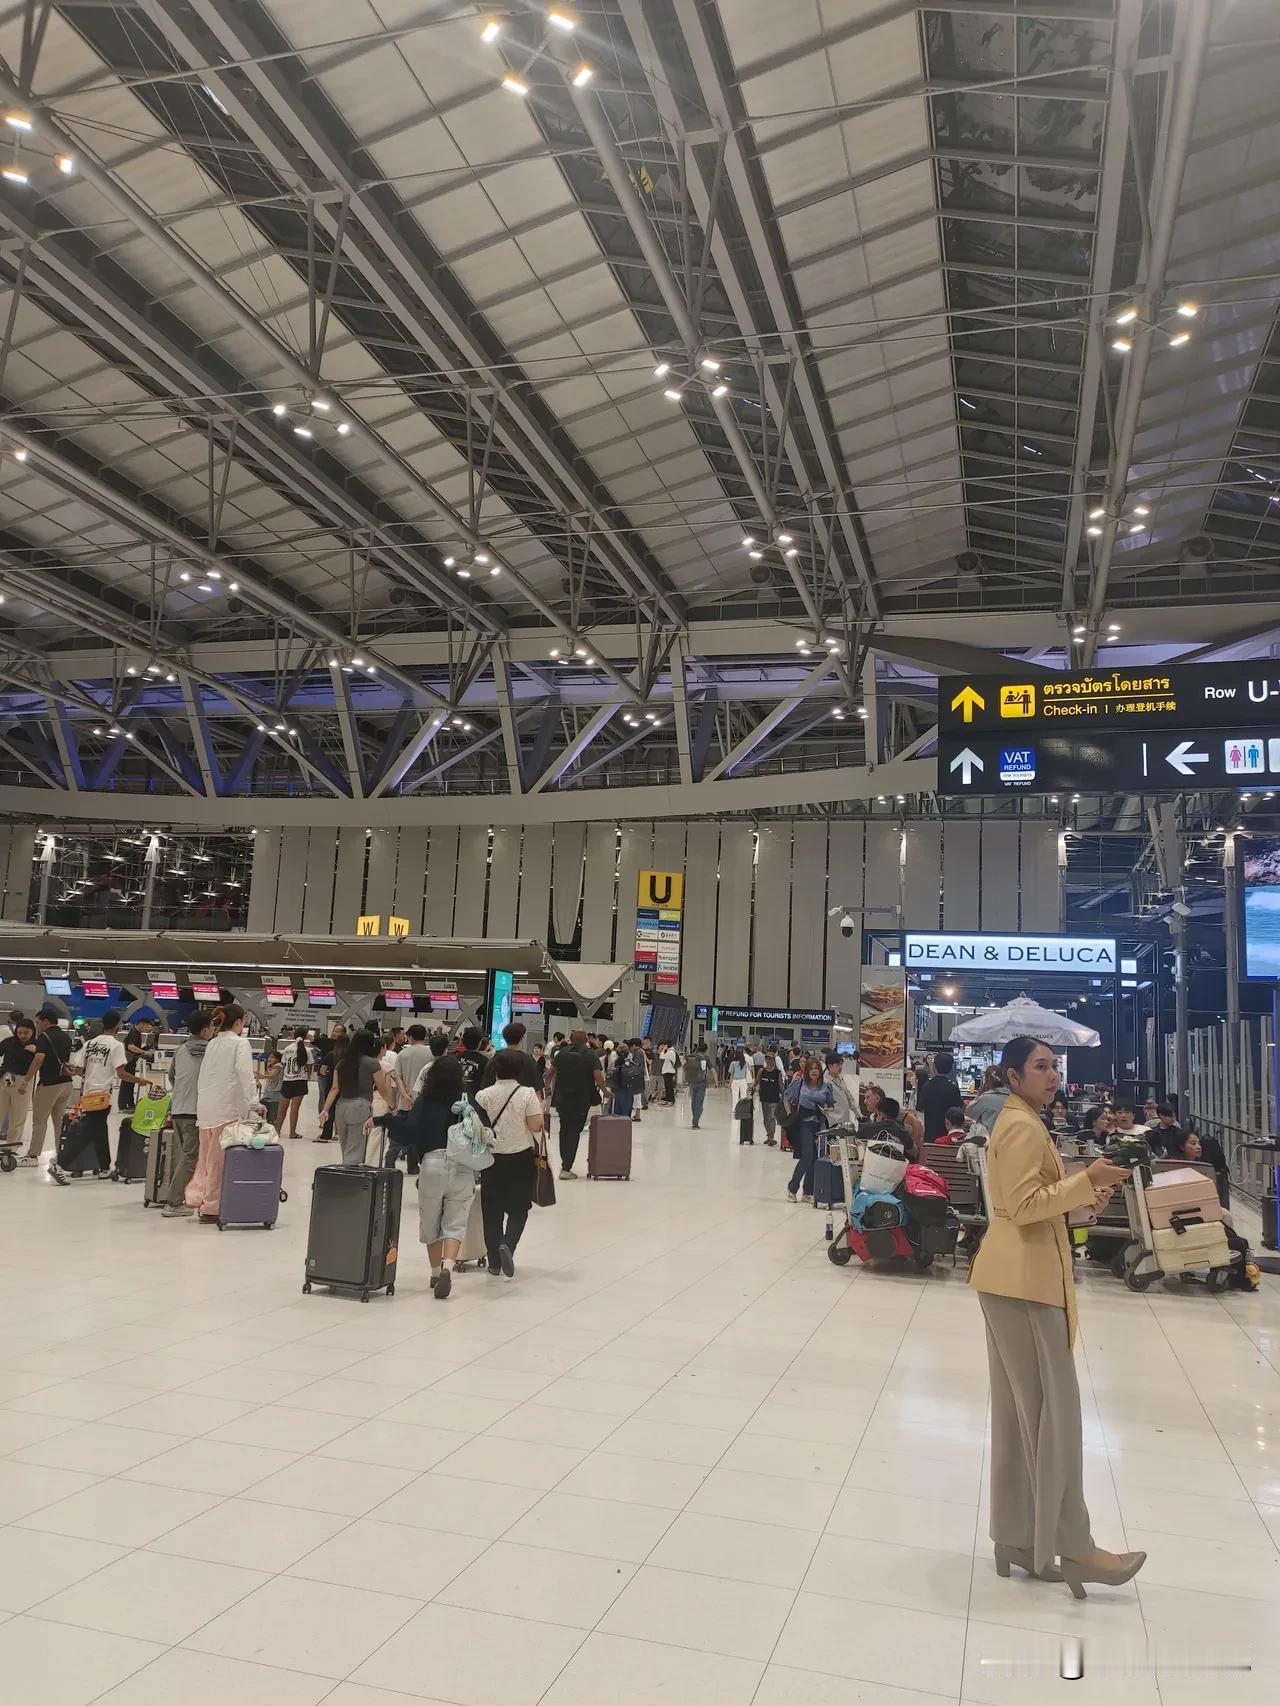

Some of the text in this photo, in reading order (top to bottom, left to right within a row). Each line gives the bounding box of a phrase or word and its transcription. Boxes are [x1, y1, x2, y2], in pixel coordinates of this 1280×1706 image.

[1043, 673, 1170, 695] ตรวจบัตรโดยสาร
[1204, 680, 1280, 703] Row U-
[1043, 703, 1098, 716] Check-in
[1115, 701, 1177, 713] 办理登机手续
[1004, 751, 1031, 764] VAT
[649, 875, 672, 904] U
[363, 921, 374, 935] W
[394, 923, 404, 936] W
[908, 944, 1113, 964] DEAN & DELUCA
[725, 1010, 749, 1018] REFUND
[763, 1012, 792, 1020] TOURISTS
[792, 1013, 832, 1021] INFORMATION
